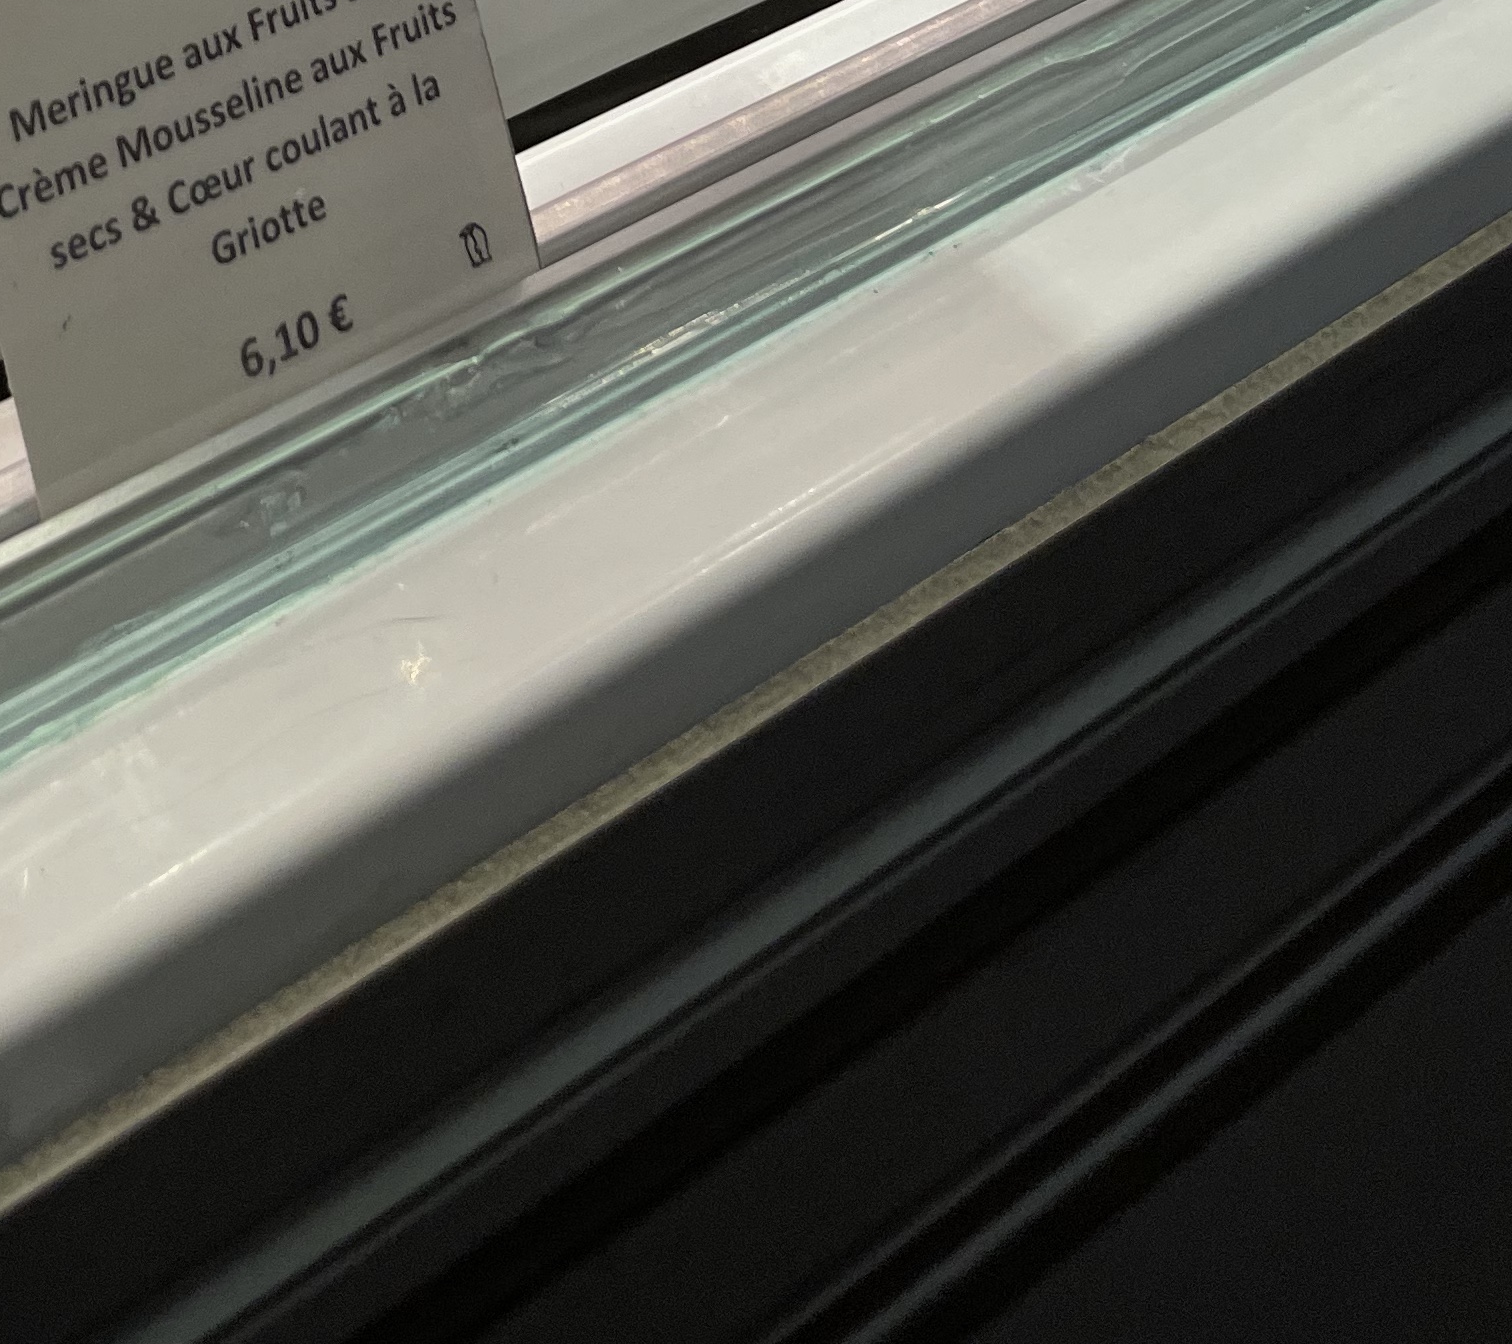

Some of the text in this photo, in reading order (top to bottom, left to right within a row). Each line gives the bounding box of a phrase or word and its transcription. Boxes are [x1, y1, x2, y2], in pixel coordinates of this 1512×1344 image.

[9, 54, 175, 142] Meringue
[182, 24, 242, 70] aux
[116, 69, 304, 168] Mousseline
[310, 40, 368, 84] aux
[372, 2, 457, 58] Fruits
[50, 73, 440, 270] secs & Cœur coulant à la
[212, 196, 326, 264] Griotte
[240, 294, 354, 378] 6,10 €
